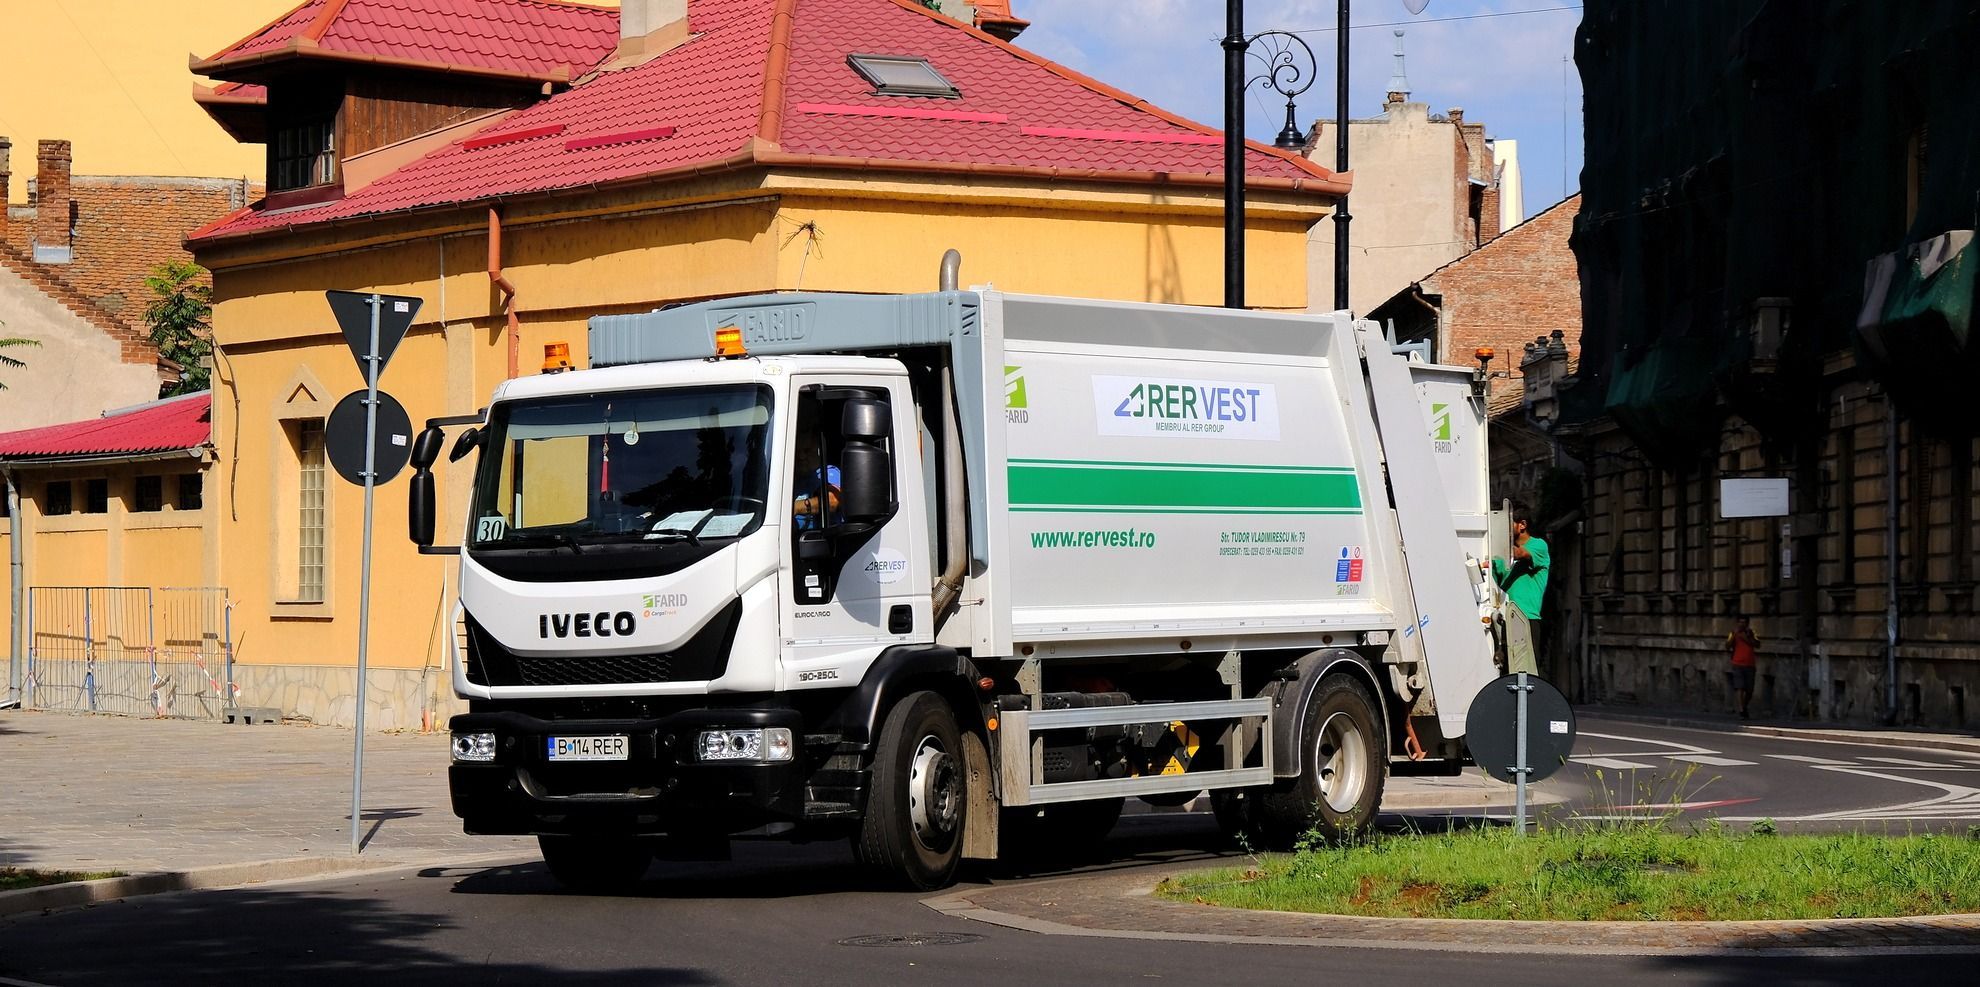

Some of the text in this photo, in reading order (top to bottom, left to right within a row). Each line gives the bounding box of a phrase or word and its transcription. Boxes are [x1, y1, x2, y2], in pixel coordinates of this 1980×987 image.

[745, 308, 805, 342] FARID
[1147, 383, 1260, 422] RER VEST
[1155, 422, 1225, 433] MEMBRU AL RER GROUP
[1434, 441, 1452, 453] FARID
[480, 520, 502, 541] 30
[1030, 527, 1155, 548] www.rervest.ro
[1220, 532, 1229, 542] Str.
[1231, 532, 1250, 542] TUDOR
[1250, 532, 1290, 542] VLADIMIRESCU
[1299, 532, 1305, 542] 79
[873, 560, 906, 571] RER VEST
[654, 593, 688, 608] FARID
[539, 611, 637, 639] IVECO
[799, 670, 838, 681] 190-250L
[558, 738, 623, 755] B 114 RER
